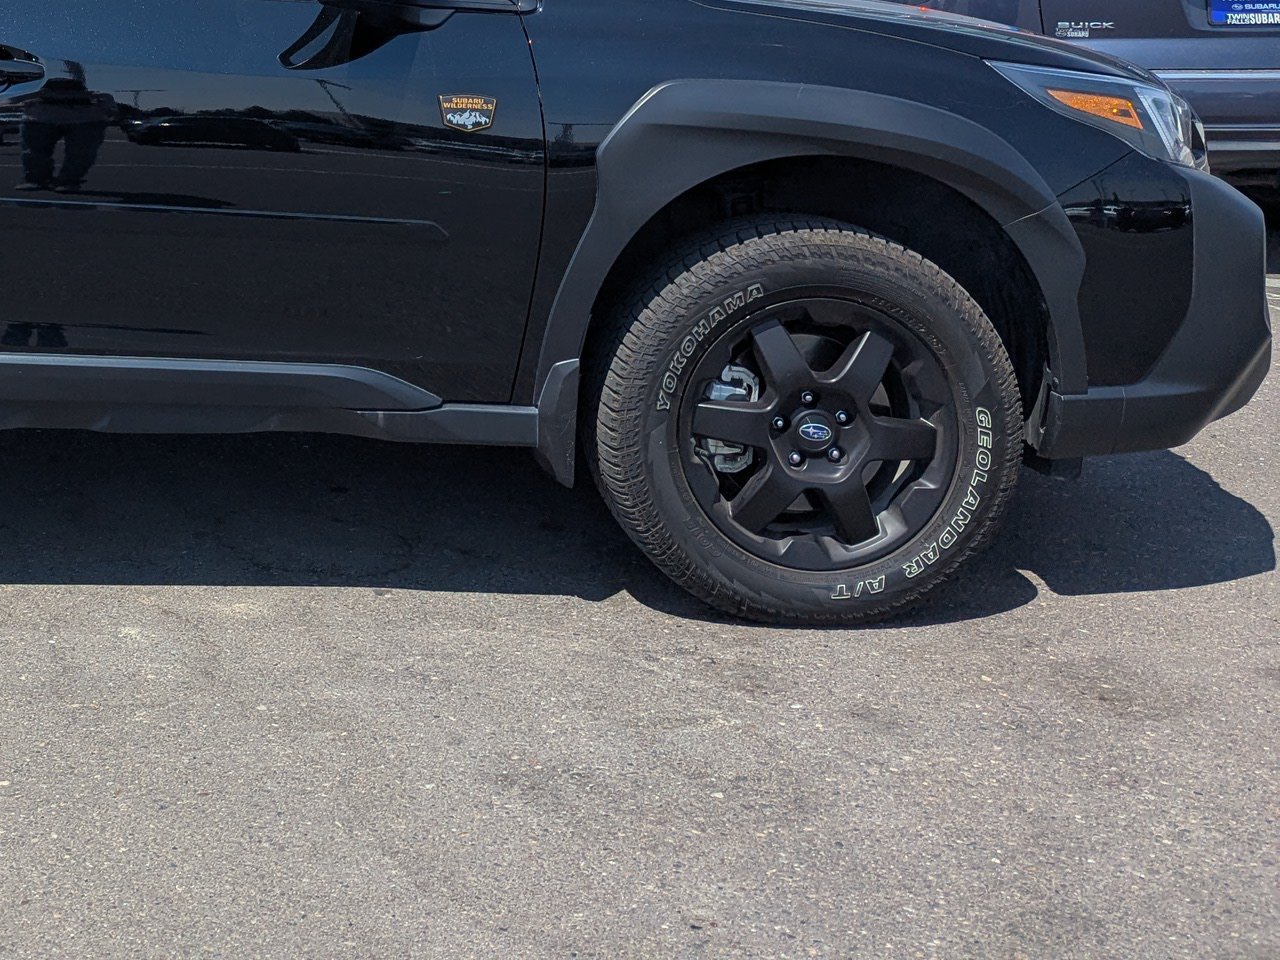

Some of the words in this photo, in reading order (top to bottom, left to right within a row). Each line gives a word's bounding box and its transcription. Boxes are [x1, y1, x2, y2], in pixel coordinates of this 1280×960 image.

[1057, 21, 1115, 29] BUICK
[443, 102, 493, 110] WILDERNESS
[656, 283, 764, 411] YOKOHAMA
[901, 406, 992, 579] GEOLANDAR
[830, 575, 885, 600] A/T
